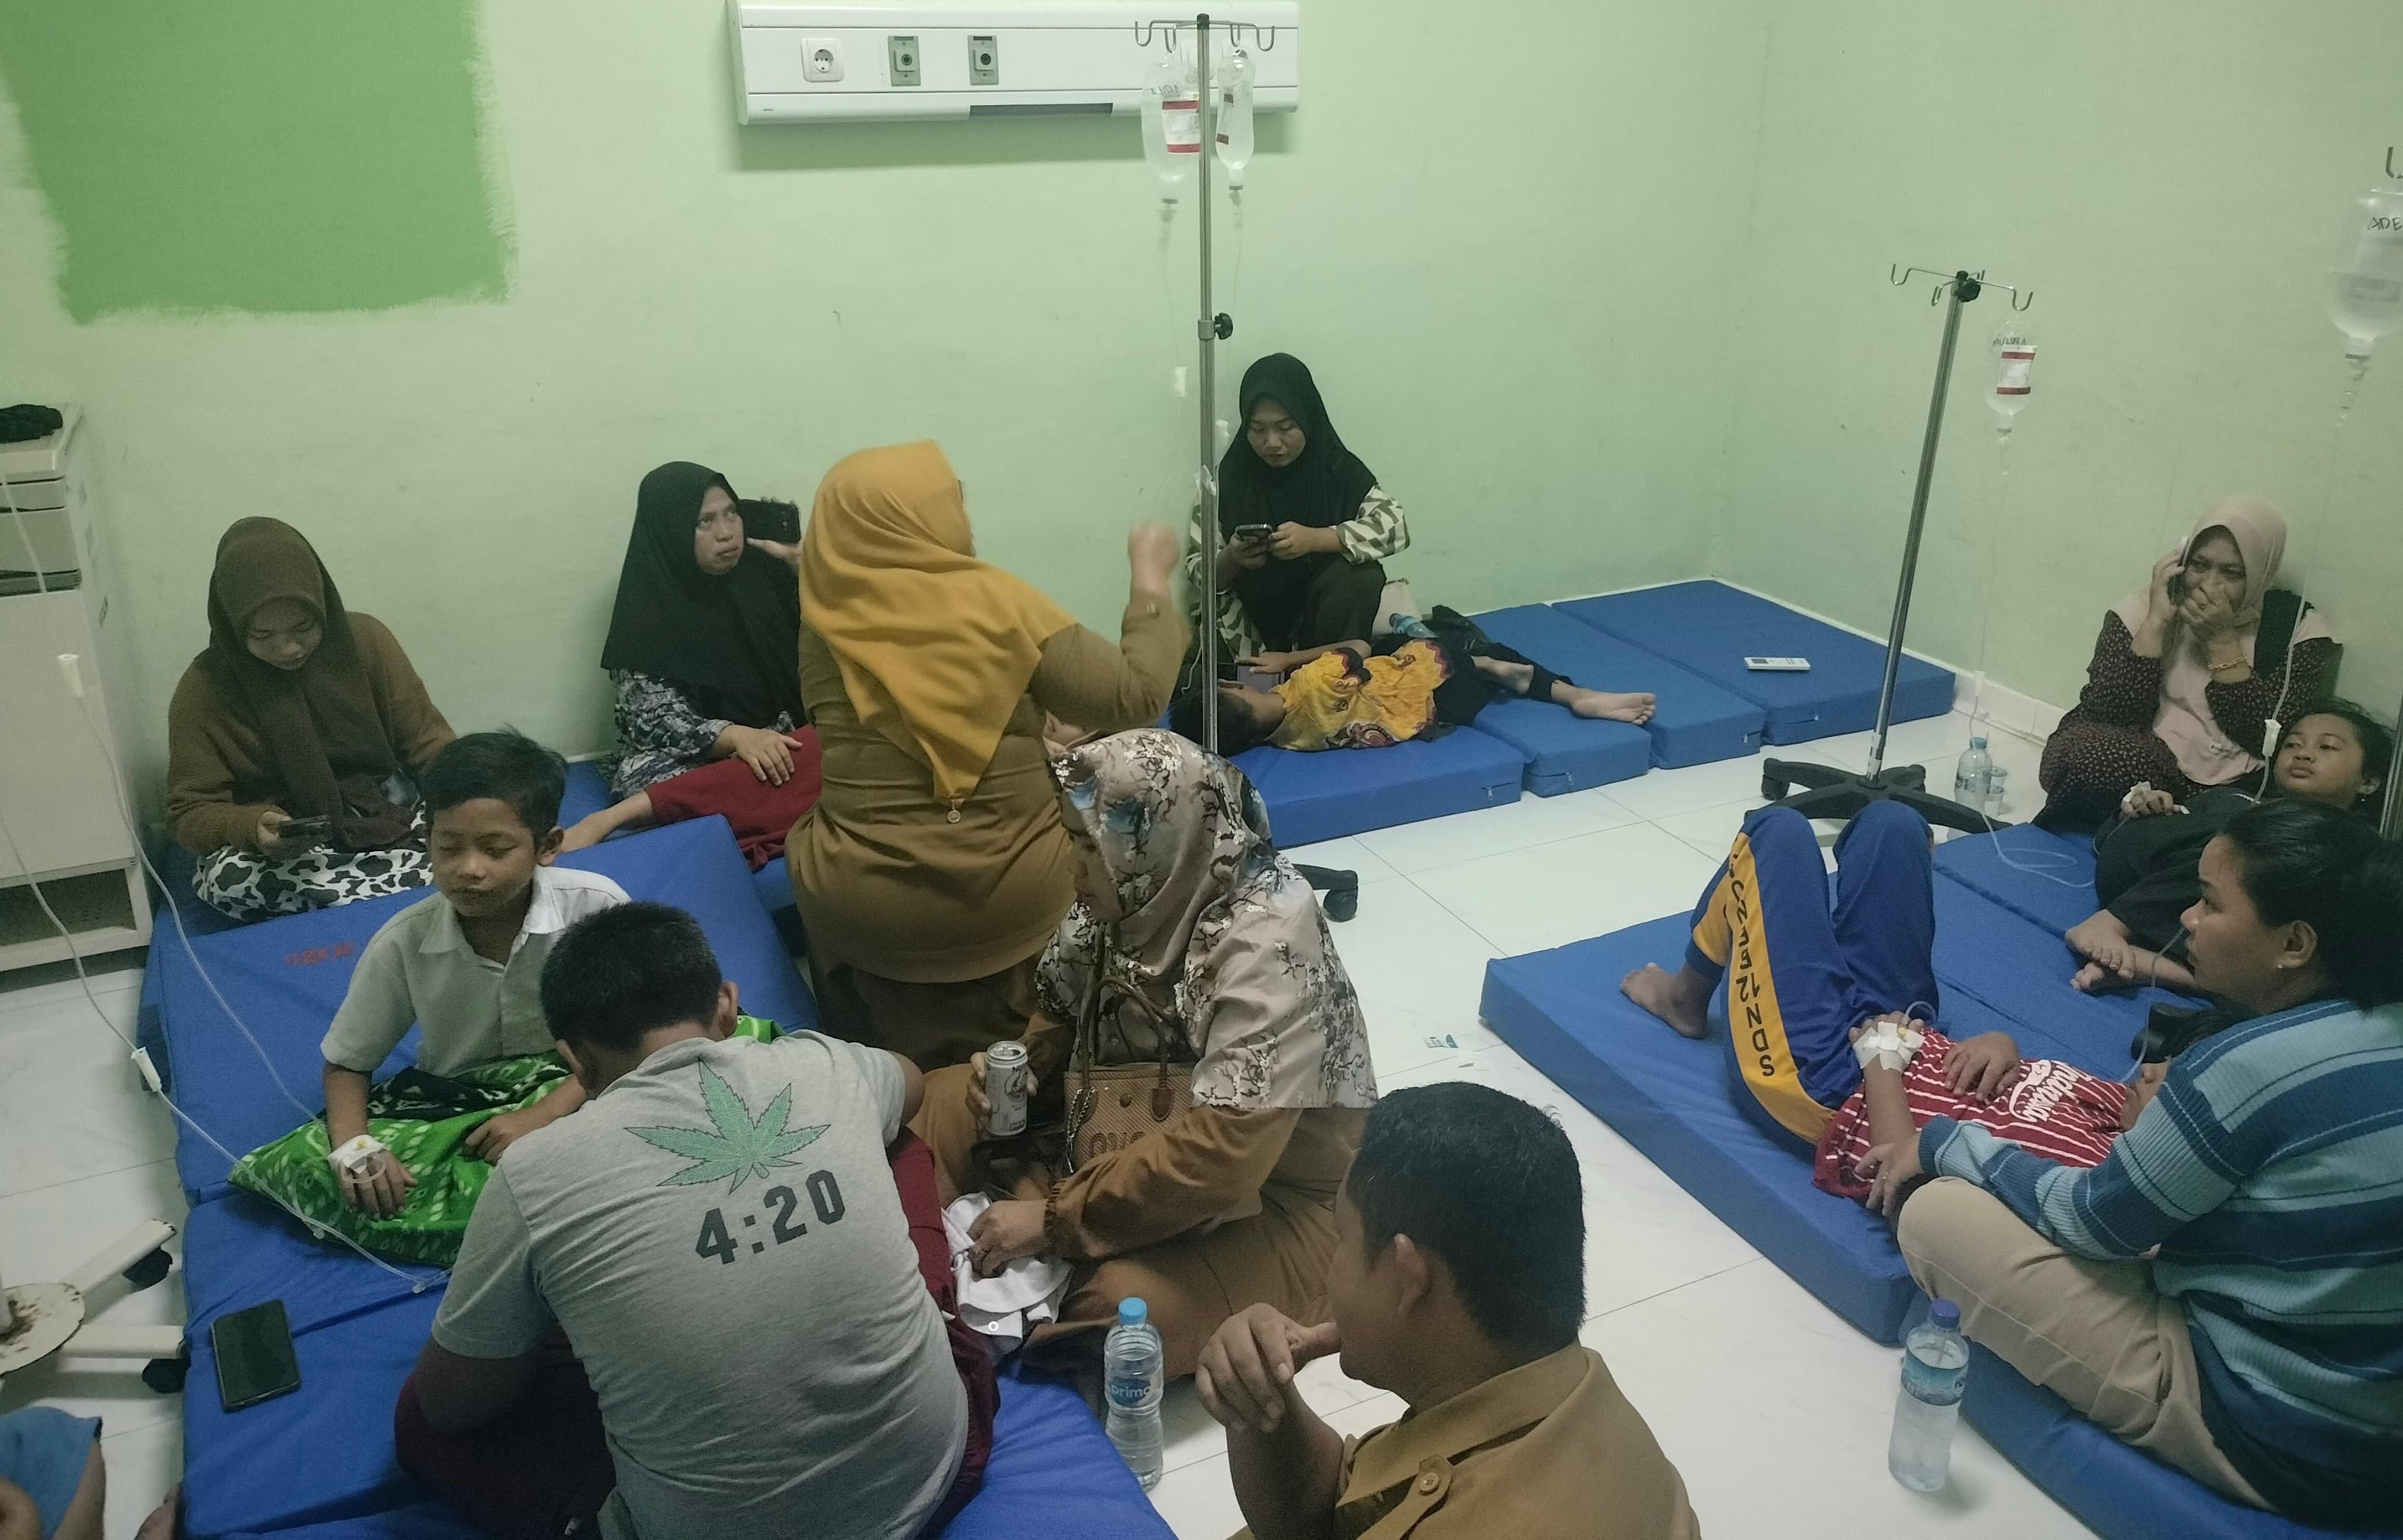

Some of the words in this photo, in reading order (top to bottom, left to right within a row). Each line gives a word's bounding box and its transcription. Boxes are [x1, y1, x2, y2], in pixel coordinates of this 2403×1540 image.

[2367, 217, 2403, 231] ADE
[1736, 972, 1760, 1003] 12
[1745, 1003, 1775, 1077] SDN
[695, 1169, 846, 1265] 4:20
